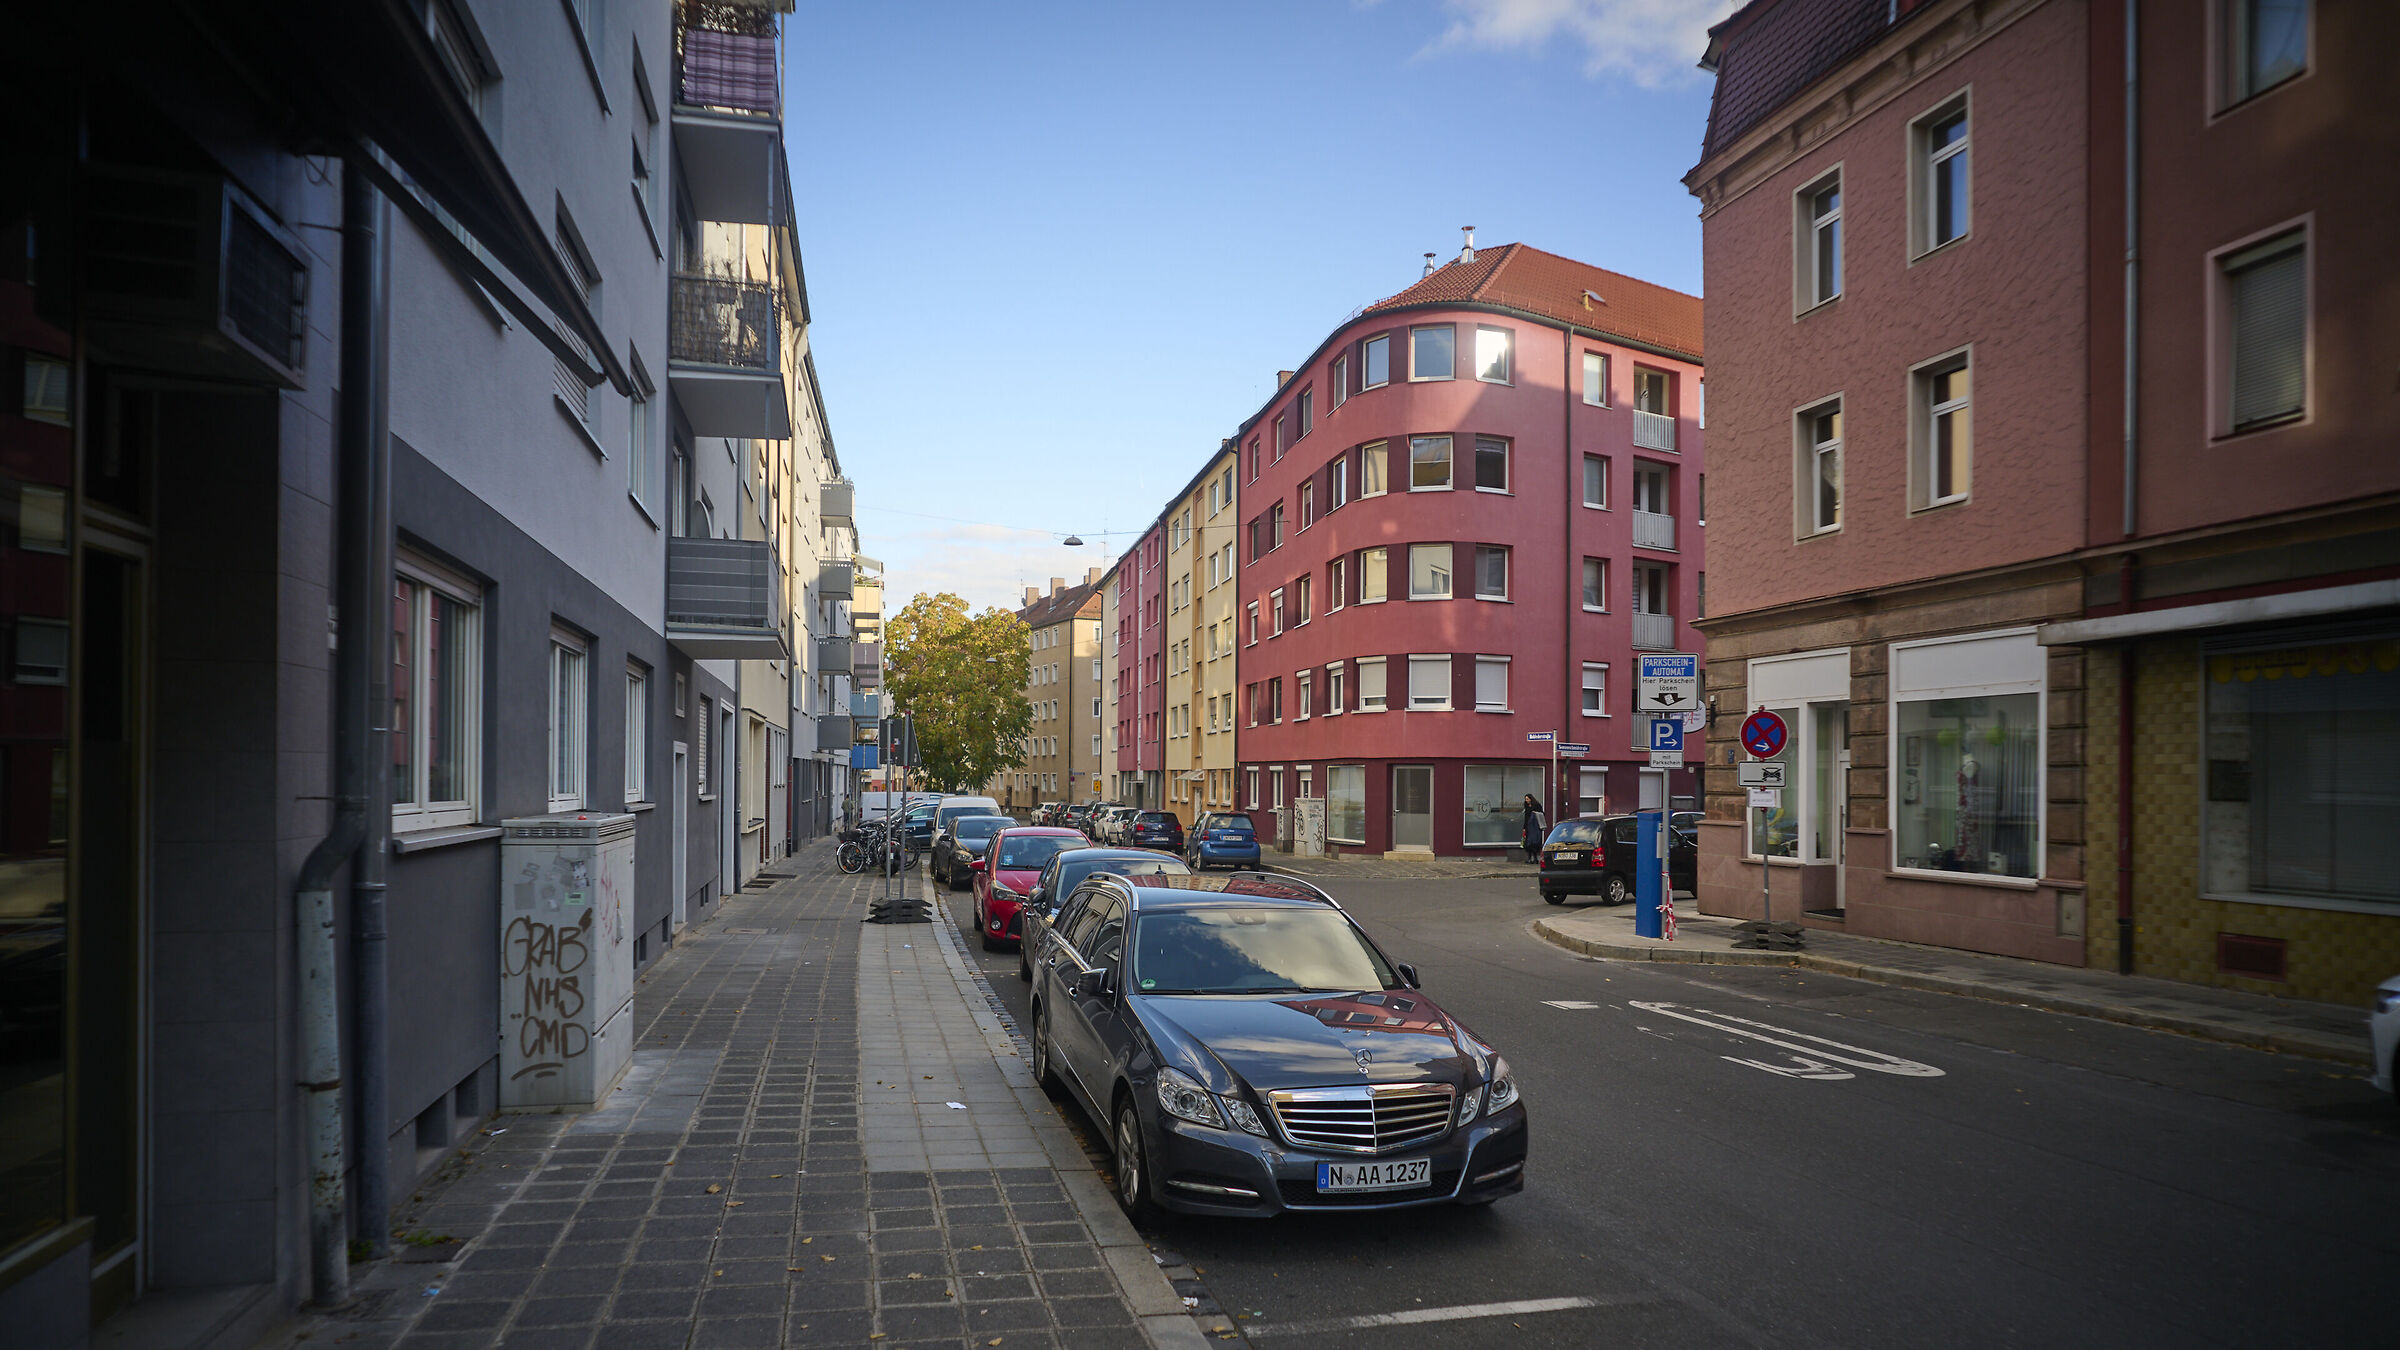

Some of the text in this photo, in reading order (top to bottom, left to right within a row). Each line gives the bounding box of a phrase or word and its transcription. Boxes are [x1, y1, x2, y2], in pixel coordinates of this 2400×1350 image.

[1644, 658, 1693, 667] PARKSCHEIN-
[1652, 667, 1685, 676] AUTOMAT
[1655, 722, 1674, 747] P
[524, 971, 584, 1019] NHS
[520, 1015, 589, 1059] CMD
[1330, 1160, 1428, 1186] N AA 1237
